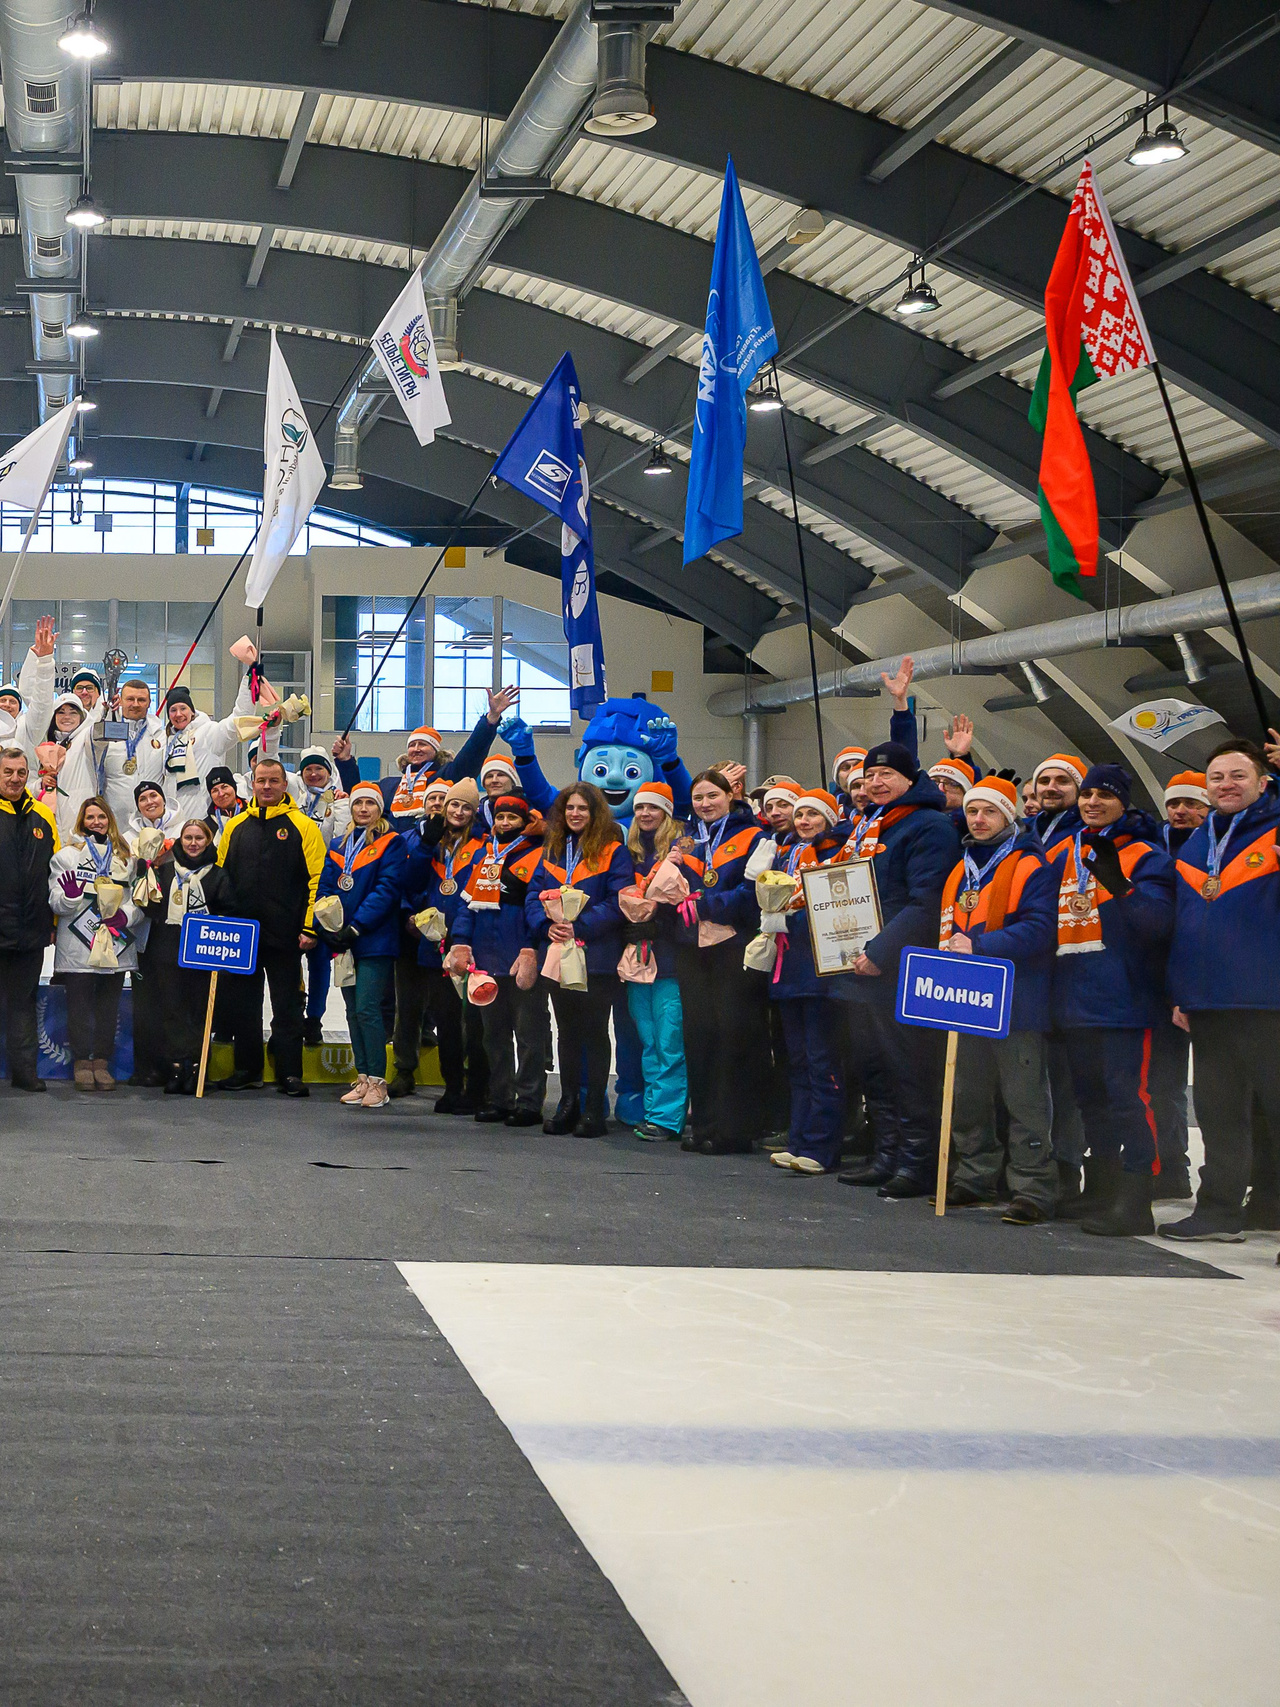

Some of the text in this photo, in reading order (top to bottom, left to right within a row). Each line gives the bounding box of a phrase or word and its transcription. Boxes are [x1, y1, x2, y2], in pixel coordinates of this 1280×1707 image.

[380, 331, 421, 400] БЕЛЫЕ ТИГРЫ
[813, 895, 871, 912] СЕРТИФИКАТ
[200, 925, 240, 943] Белые
[195, 944, 241, 961] тигры
[914, 976, 994, 1009] Молния
